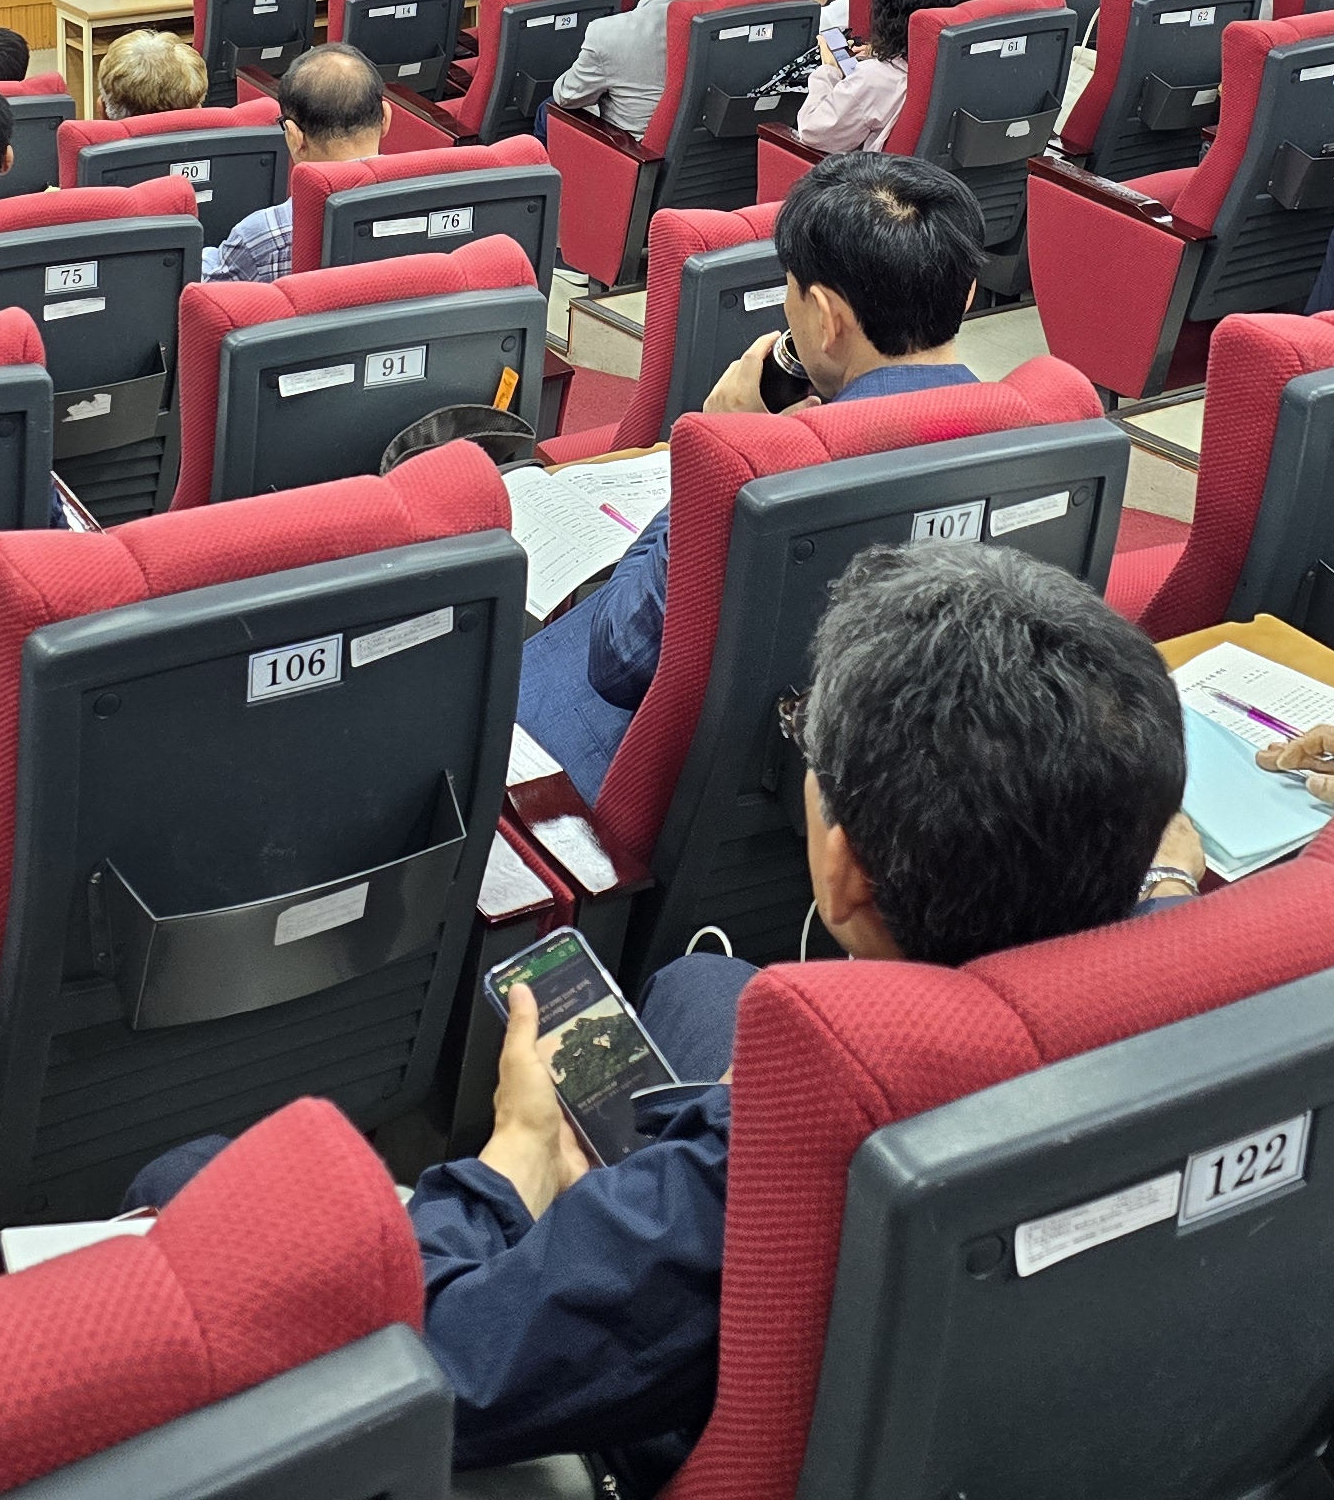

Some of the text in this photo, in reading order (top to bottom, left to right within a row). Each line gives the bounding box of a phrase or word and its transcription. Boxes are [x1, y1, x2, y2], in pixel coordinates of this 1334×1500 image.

[401, 6, 412, 16] 14
[1197, 10, 1209, 21] 62
[560, 16, 572, 26] 29
[755, 27, 767, 38] 45
[1007, 41, 1019, 51] 61
[180, 165, 199, 180] 60
[441, 213, 460, 229] 76
[60, 268, 83, 285] 75
[381, 354, 408, 377] 91
[926, 510, 973, 539] 107
[266, 648, 327, 687] 106
[1205, 1132, 1288, 1202] 122
